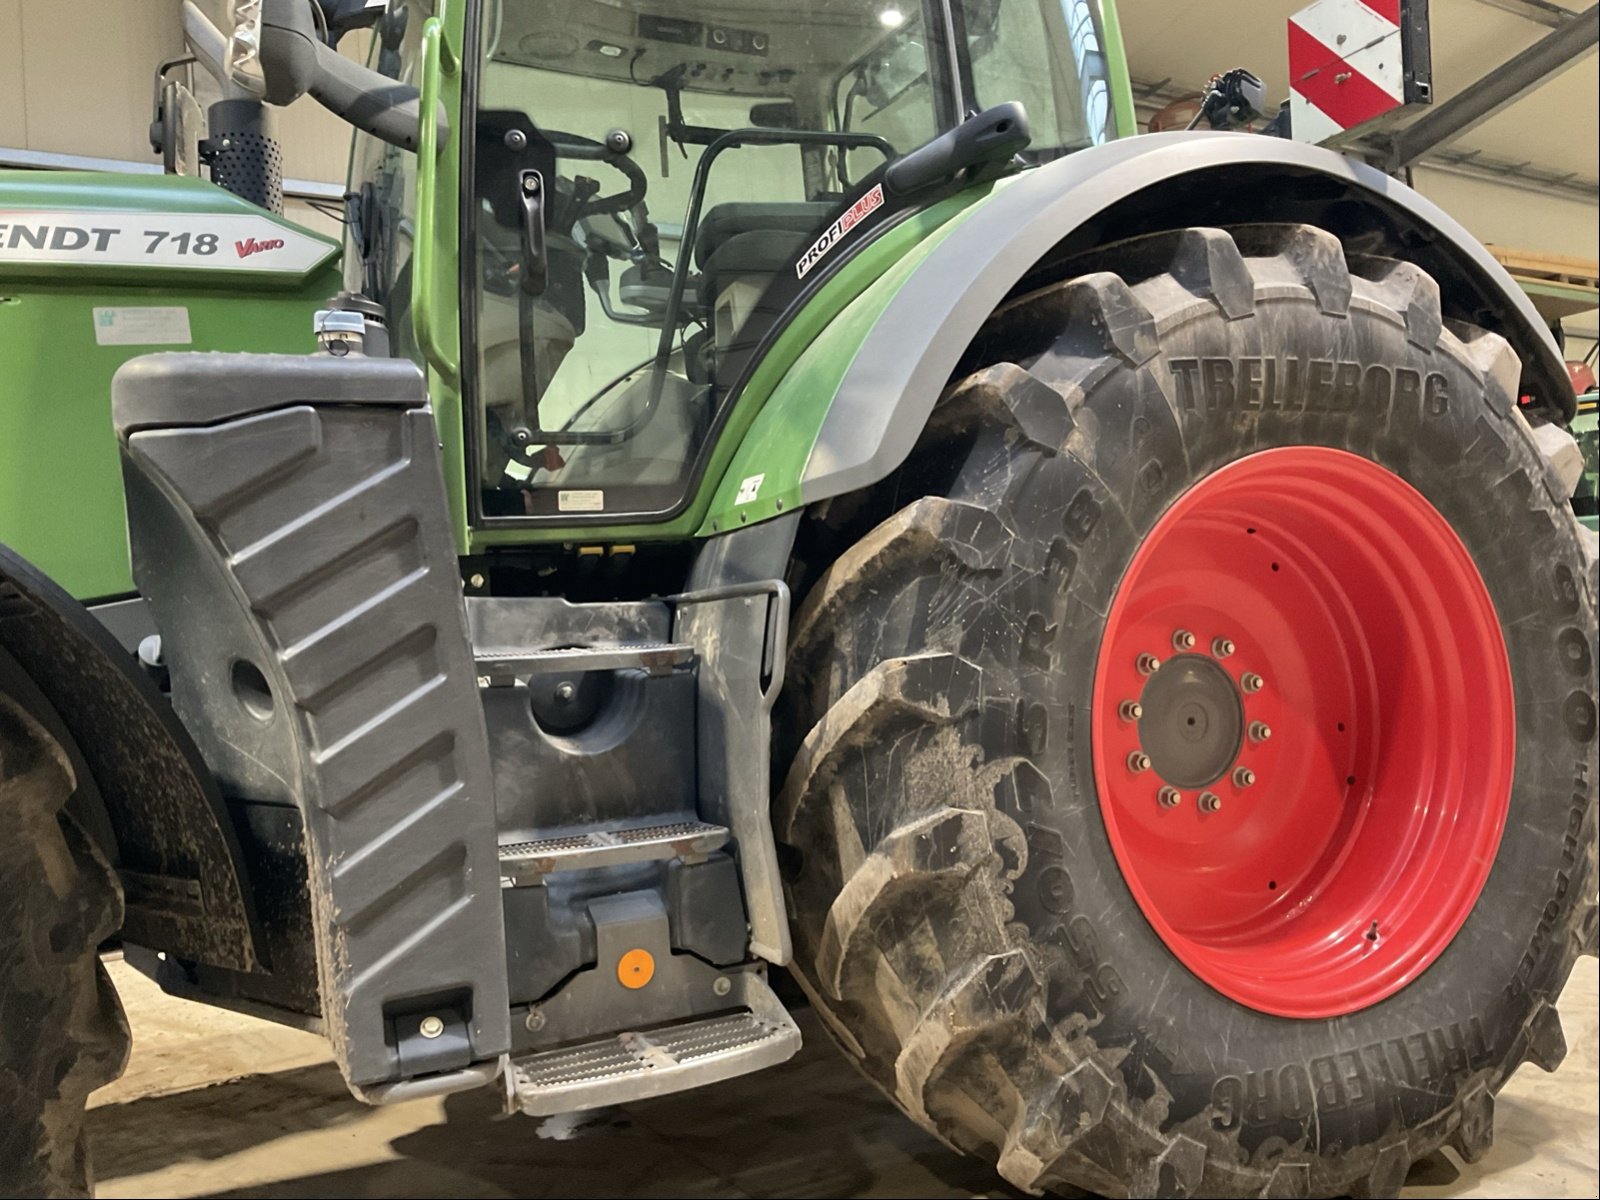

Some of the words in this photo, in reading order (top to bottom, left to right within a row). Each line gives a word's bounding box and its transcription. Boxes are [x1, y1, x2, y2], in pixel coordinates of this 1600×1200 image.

[143, 231, 219, 255] 718
[1168, 355, 1450, 418] TRELLEBORG
[1560, 760, 1589, 869] HIGH
